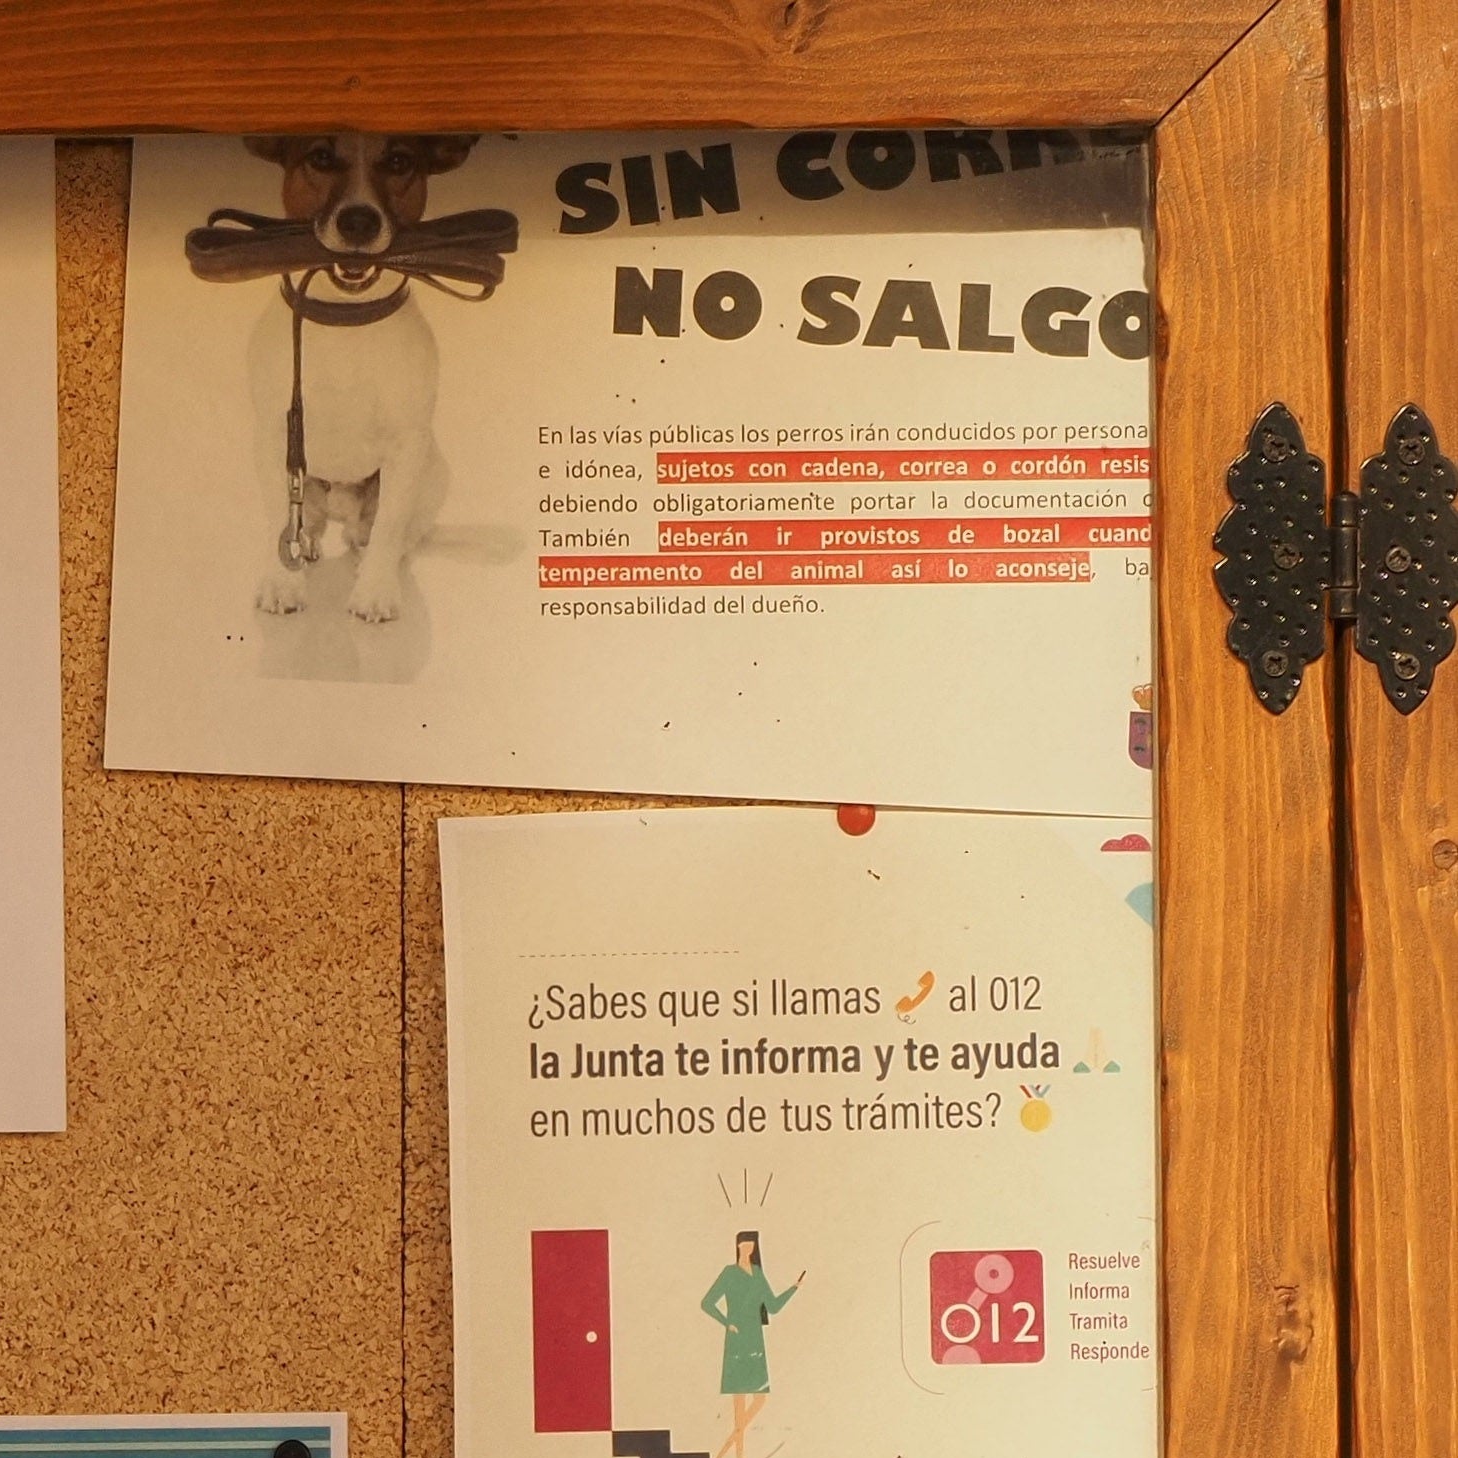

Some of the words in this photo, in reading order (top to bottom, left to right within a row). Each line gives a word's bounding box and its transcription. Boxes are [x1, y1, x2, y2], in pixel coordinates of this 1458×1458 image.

[557, 143, 740, 234] SIN
[557, 143, 740, 234] SIN
[613, 267, 763, 341] NO
[797, 276, 1152, 361] SALGO
[541, 596, 705, 619] responsabilidad
[714, 595, 744, 614] del
[752, 595, 824, 613] dueño.
[529, 983, 647, 1029] ¿Sabes
[658, 990, 719, 1027] que
[733, 980, 757, 1016] si
[772, 979, 880, 1016] llamas
[949, 975, 976, 1012] al
[990, 976, 1041, 1011] 012
[530, 1043, 559, 1079] la
[571, 1043, 664, 1078] Junta
[675, 1043, 709, 1076] te
[722, 1038, 860, 1075] informa
[874, 1045, 894, 1081] y
[904, 1038, 939, 1071] te
[951, 1032, 1059, 1079] ayuda
[1069, 1252, 1140, 1270] Resuelve
[1070, 1282, 1129, 1299] Informa
[941, 1302, 1038, 1343] 012
[1069, 1312, 1128, 1330] Tramita
